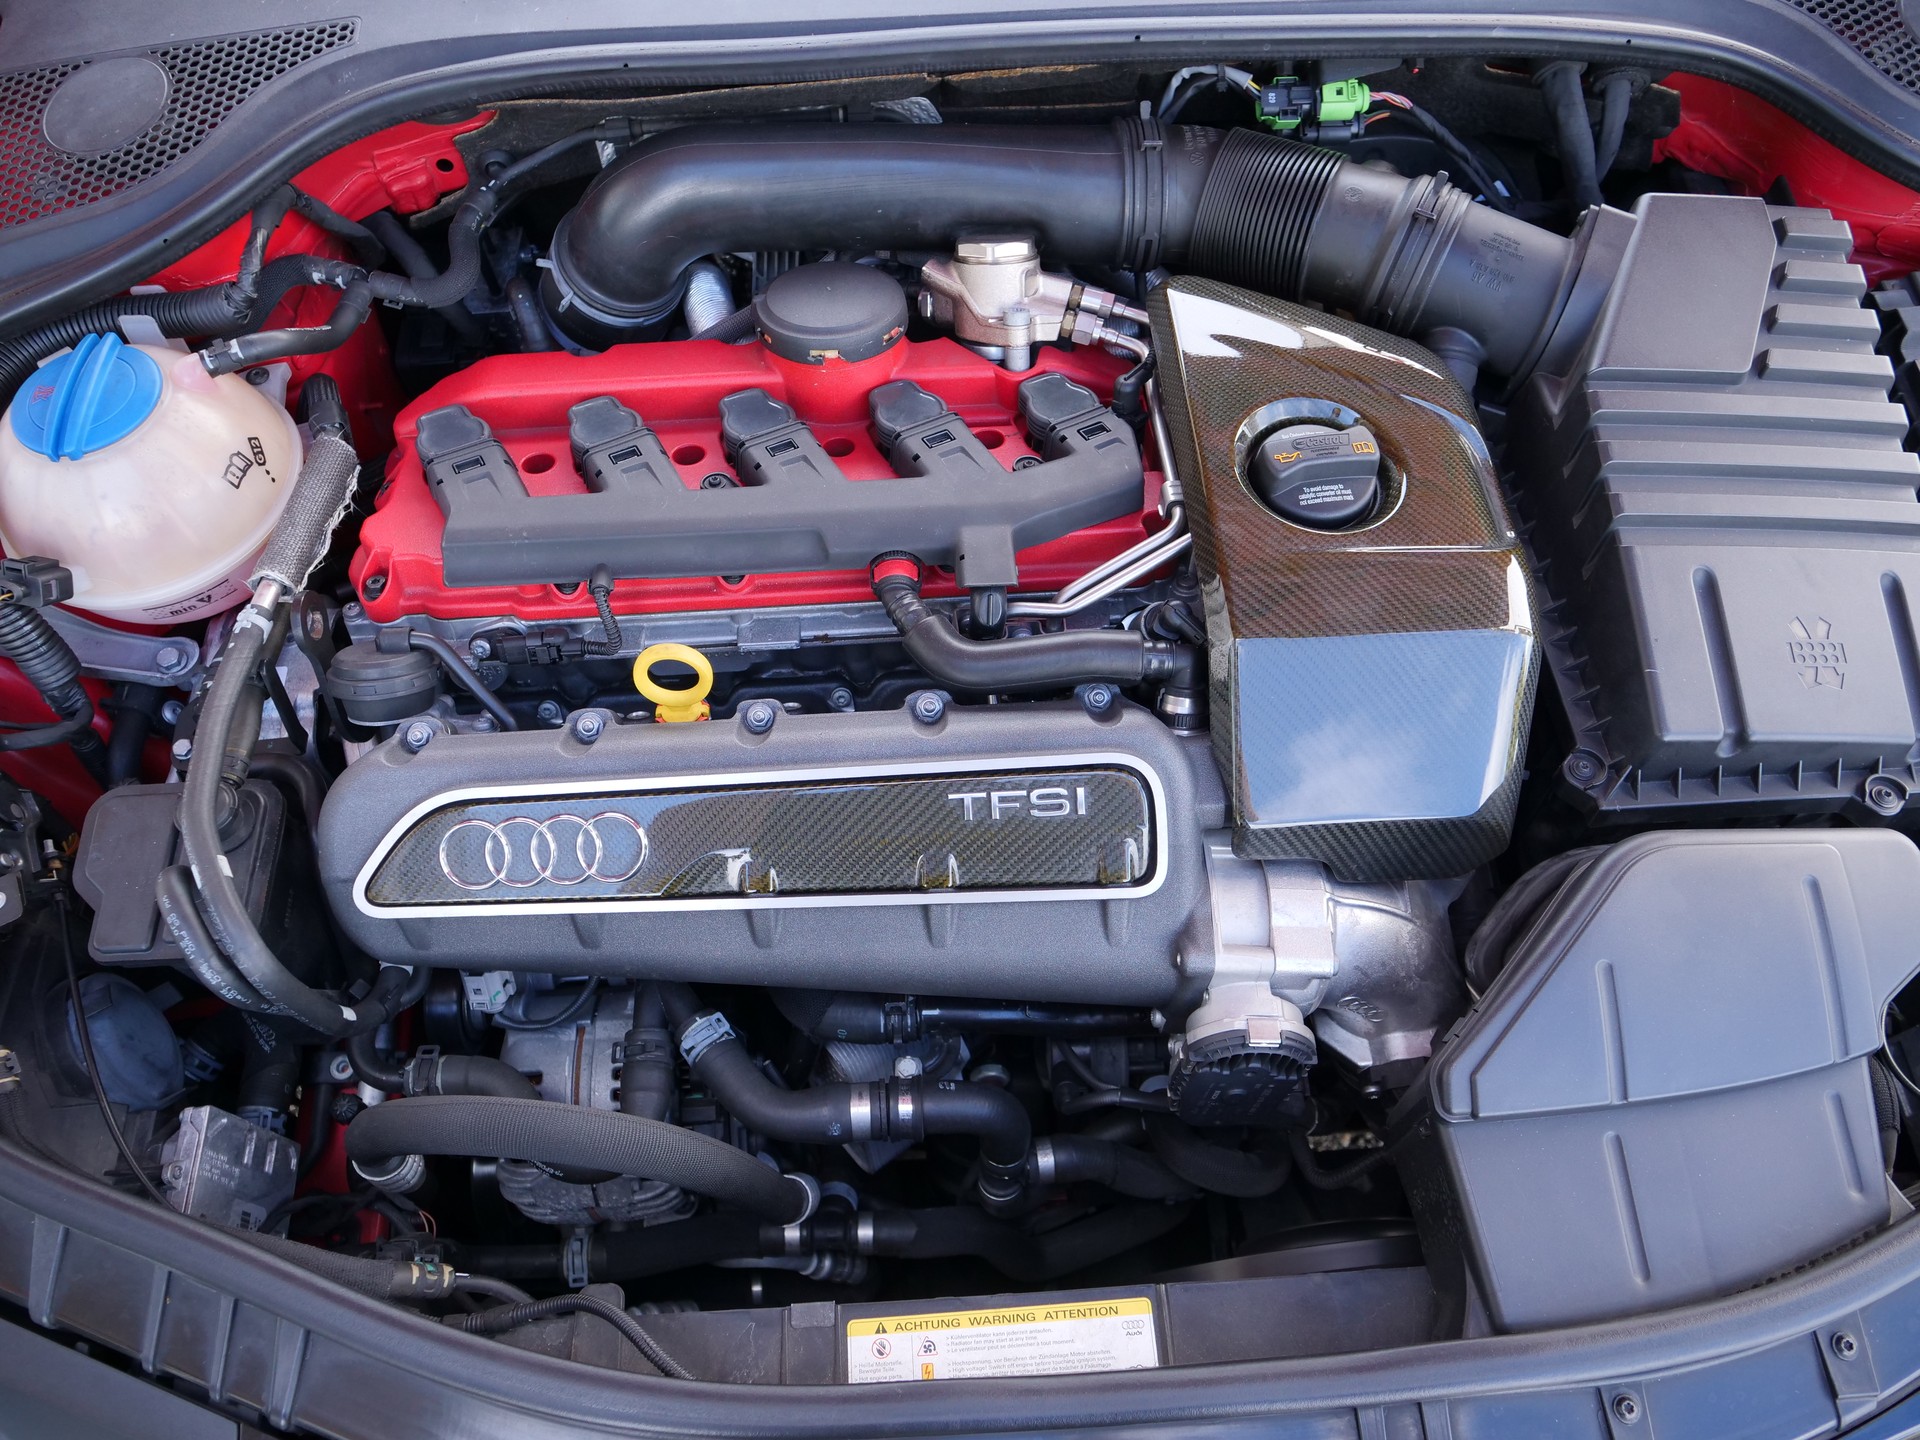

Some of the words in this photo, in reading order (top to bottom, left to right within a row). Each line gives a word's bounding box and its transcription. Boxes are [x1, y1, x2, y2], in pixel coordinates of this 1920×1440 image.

[251, 439, 265, 464] G12
[1306, 436, 1343, 447] Castrol
[170, 605, 197, 616] min
[948, 787, 1086, 820] TFSI
[894, 1318, 961, 1332] ACHTUNG
[968, 1312, 1036, 1326] WARNING
[1044, 1306, 1118, 1320] ATTENTION
